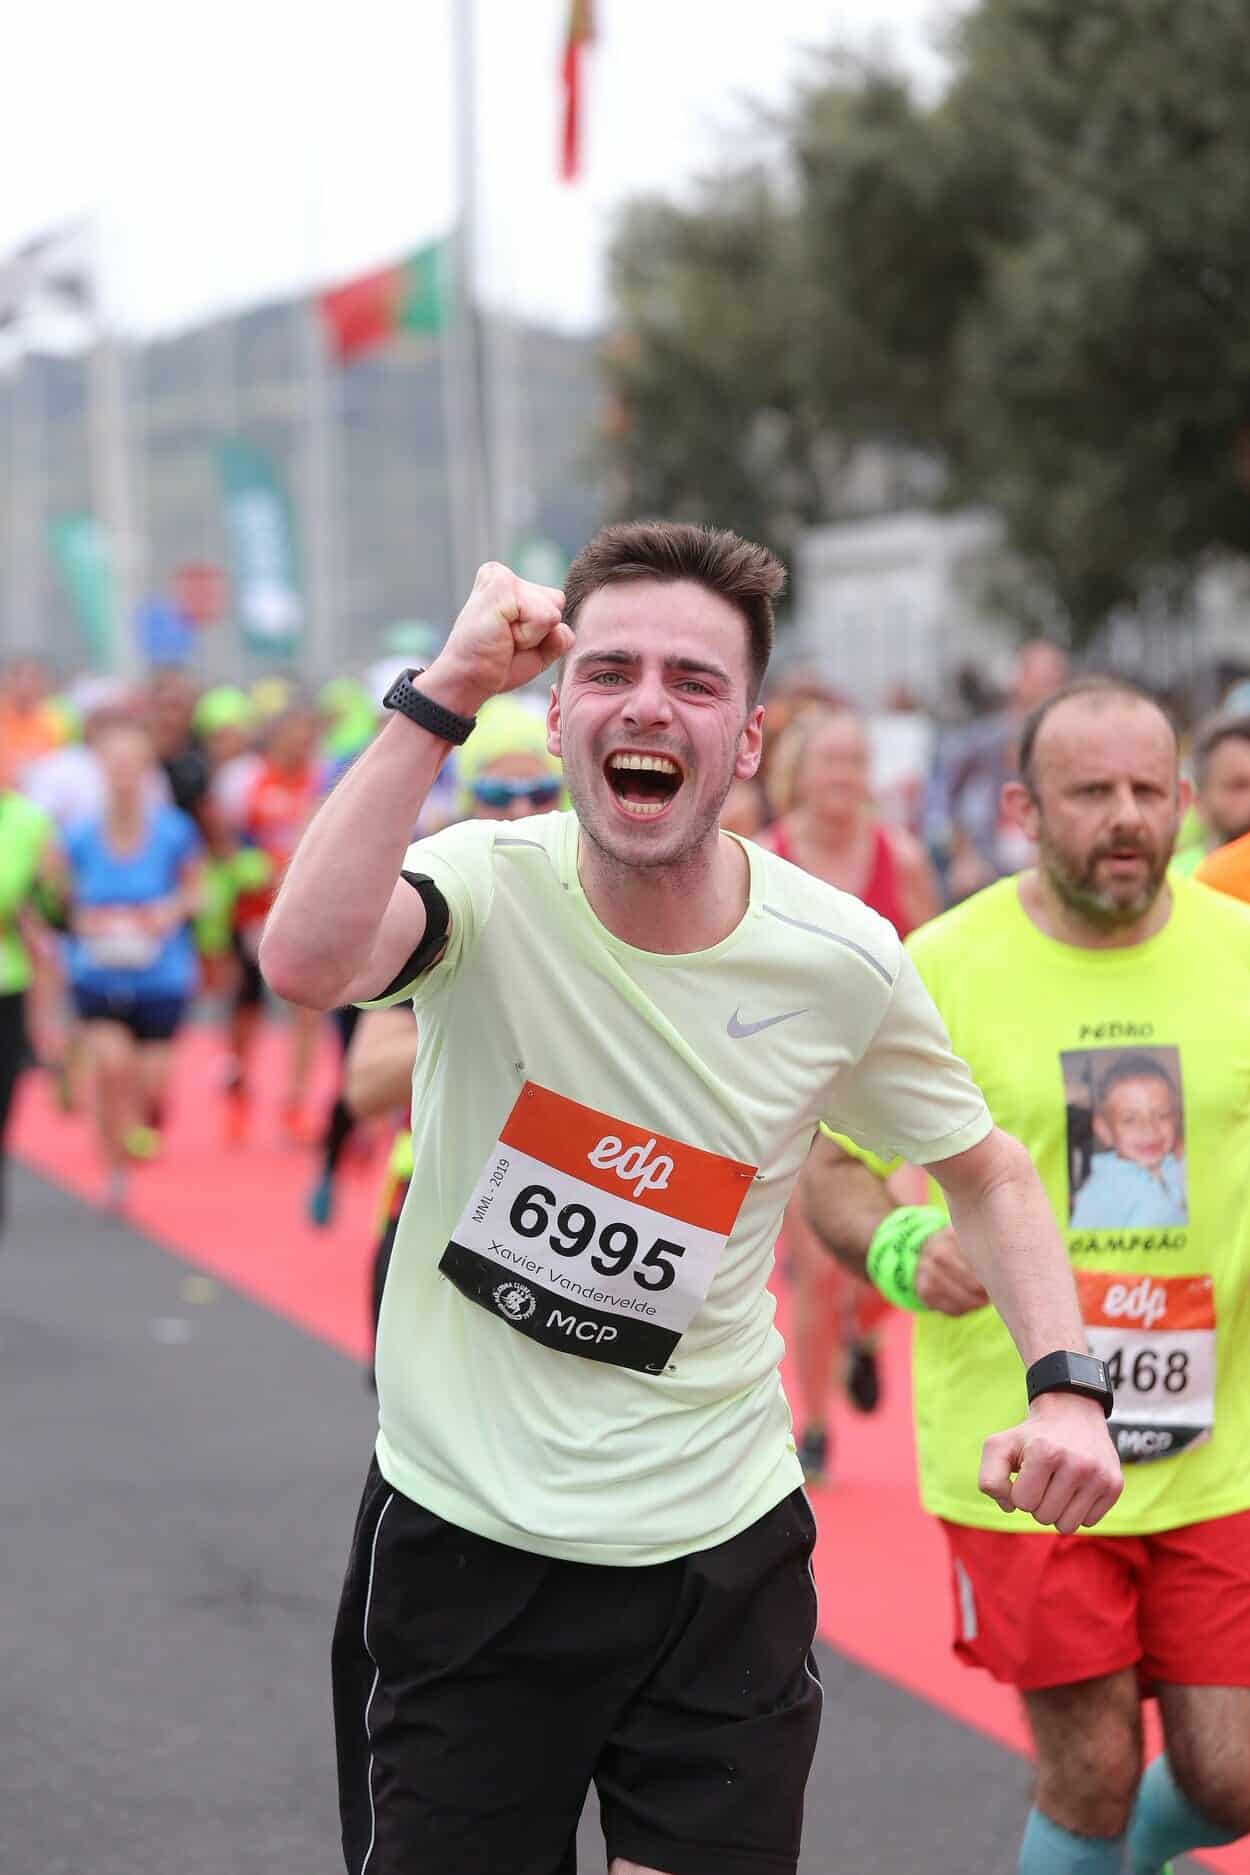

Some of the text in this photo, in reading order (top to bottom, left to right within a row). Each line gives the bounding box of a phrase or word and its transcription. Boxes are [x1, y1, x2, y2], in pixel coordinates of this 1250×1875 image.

[471, 1195, 494, 1224] MML
[490, 1159, 510, 1187] 2019
[588, 1135, 673, 1197] edp
[510, 1185, 686, 1292] 6995
[488, 1240, 544, 1274] Xavier
[549, 1269, 657, 1316] Vandervelde
[1103, 1277, 1167, 1328] edp
[546, 1310, 617, 1344] MCP
[1088, 1347, 1188, 1392] 468
[1117, 1430, 1172, 1454] MCP
